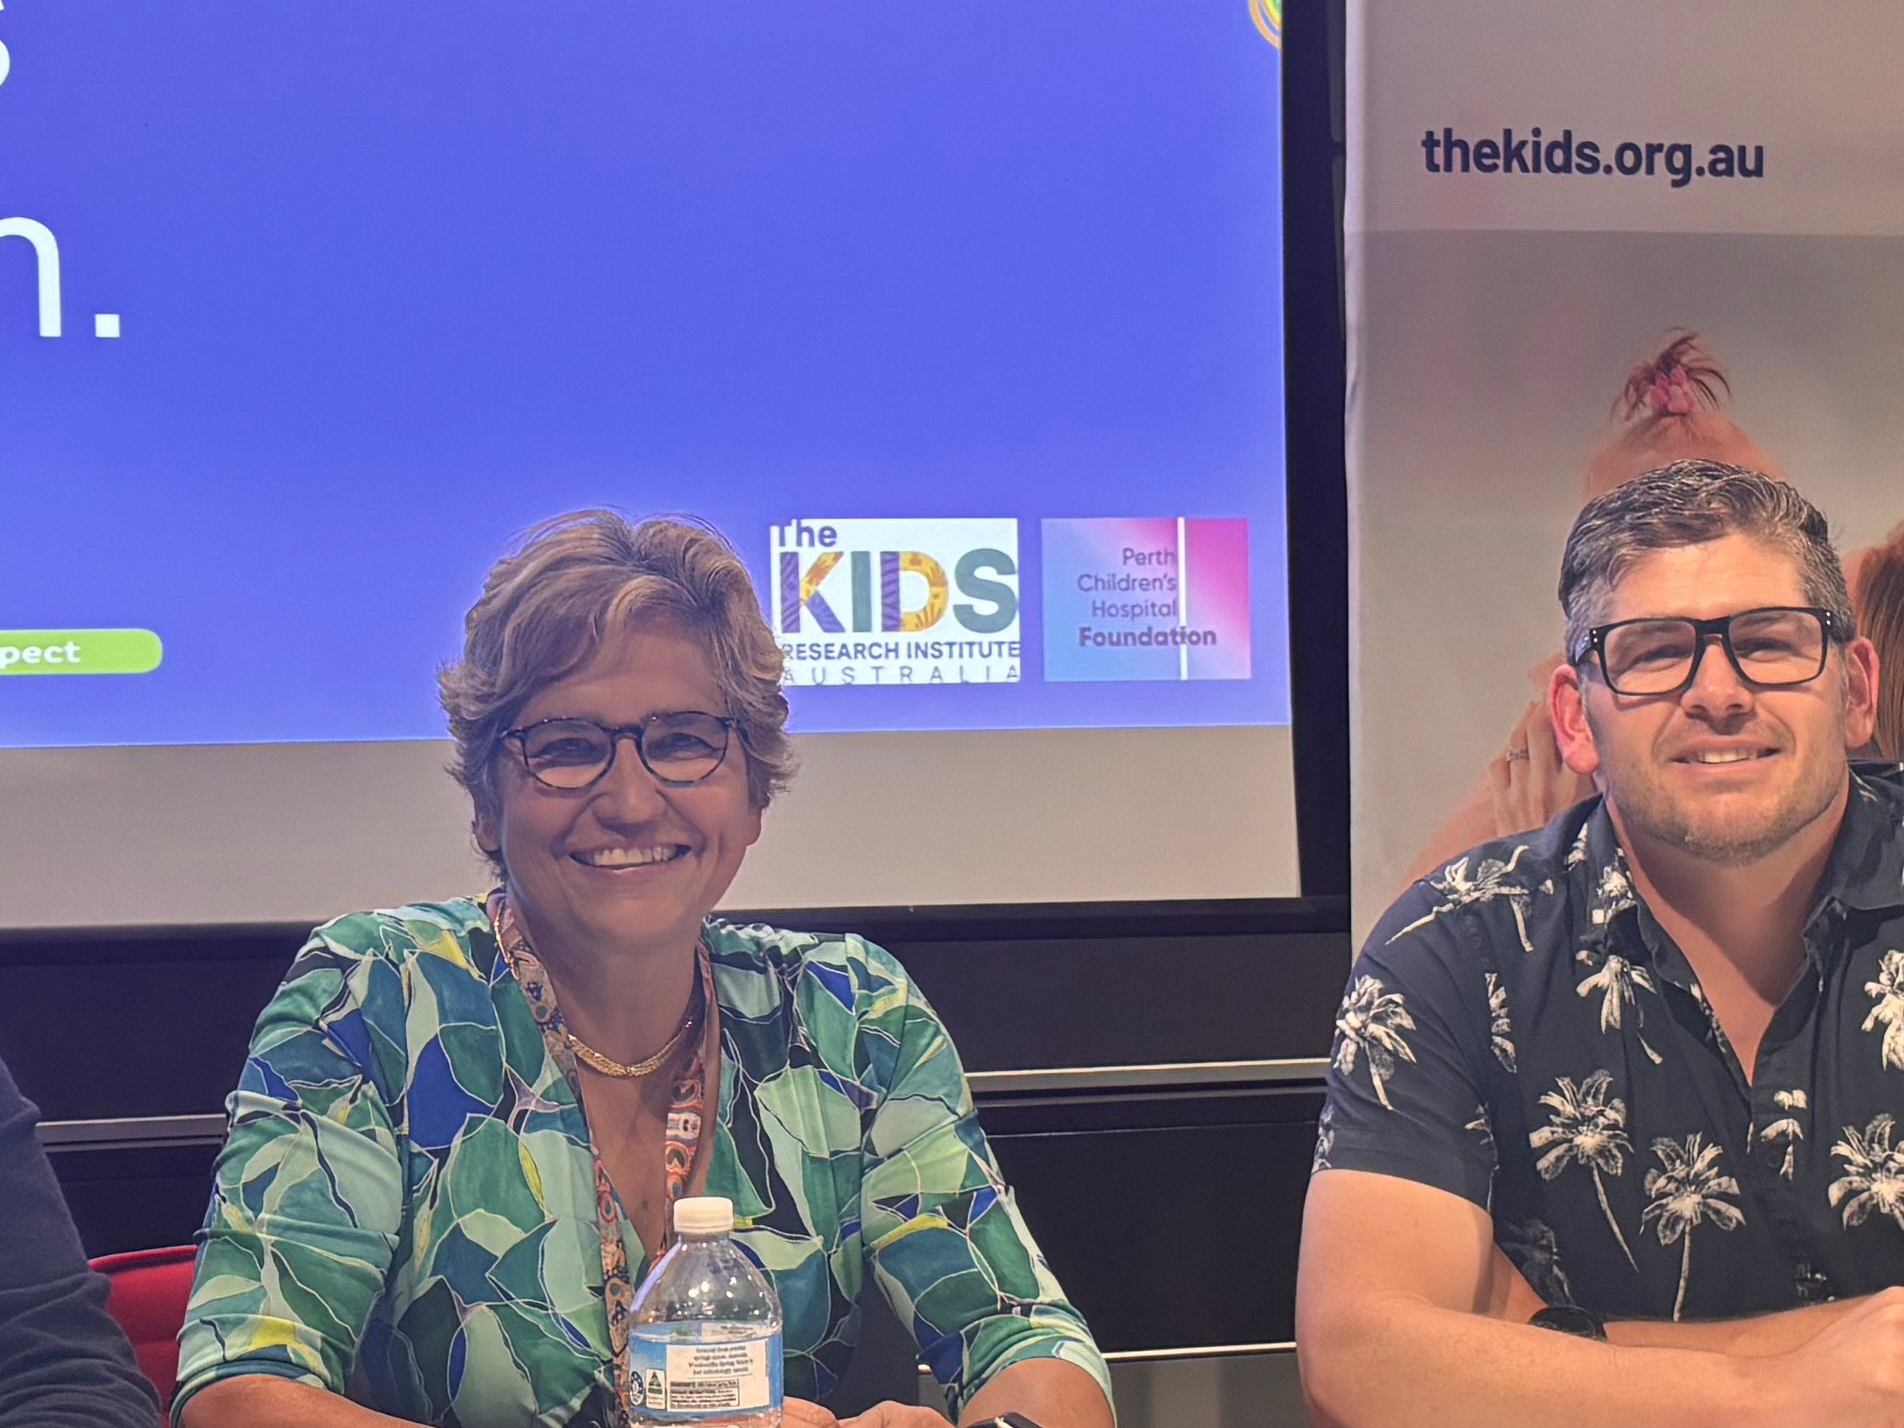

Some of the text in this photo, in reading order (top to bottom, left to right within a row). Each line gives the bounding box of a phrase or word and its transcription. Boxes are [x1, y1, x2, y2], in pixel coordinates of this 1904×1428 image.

[1422, 127, 1764, 188] thekids.org.au
[1122, 547, 1176, 566] Perth
[780, 548, 1017, 633] KIDS
[1077, 573, 1177, 592] Children's
[1092, 600, 1177, 621] Hospital
[1079, 625, 1217, 647] Foundation
[783, 641, 1021, 660] RESEARCH INSTITUTE
